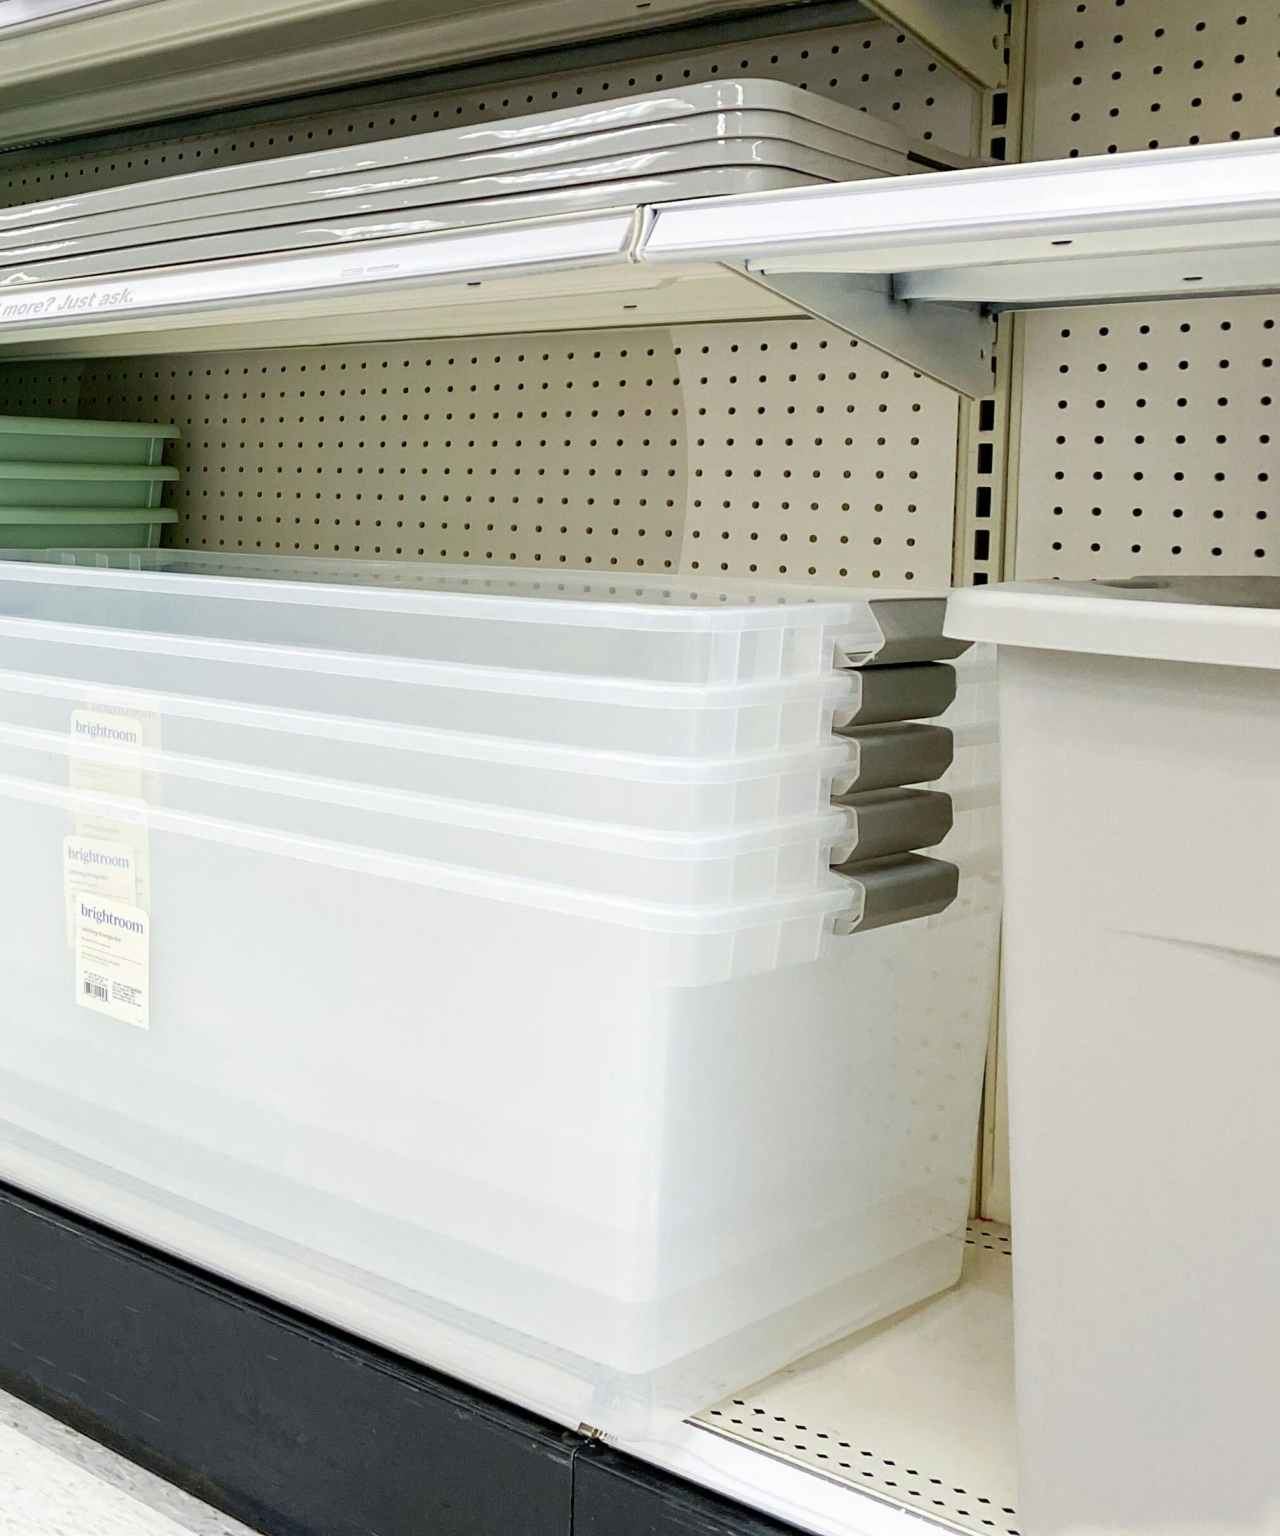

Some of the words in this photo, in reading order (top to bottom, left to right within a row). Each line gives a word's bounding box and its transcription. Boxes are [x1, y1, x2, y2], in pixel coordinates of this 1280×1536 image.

[1, 297, 57, 319] more?
[57, 293, 97, 311] Just
[98, 287, 135, 305] ask.
[75, 719, 137, 744] brightroom
[67, 844, 131, 869] brightroom
[80, 903, 145, 935] brightroom
